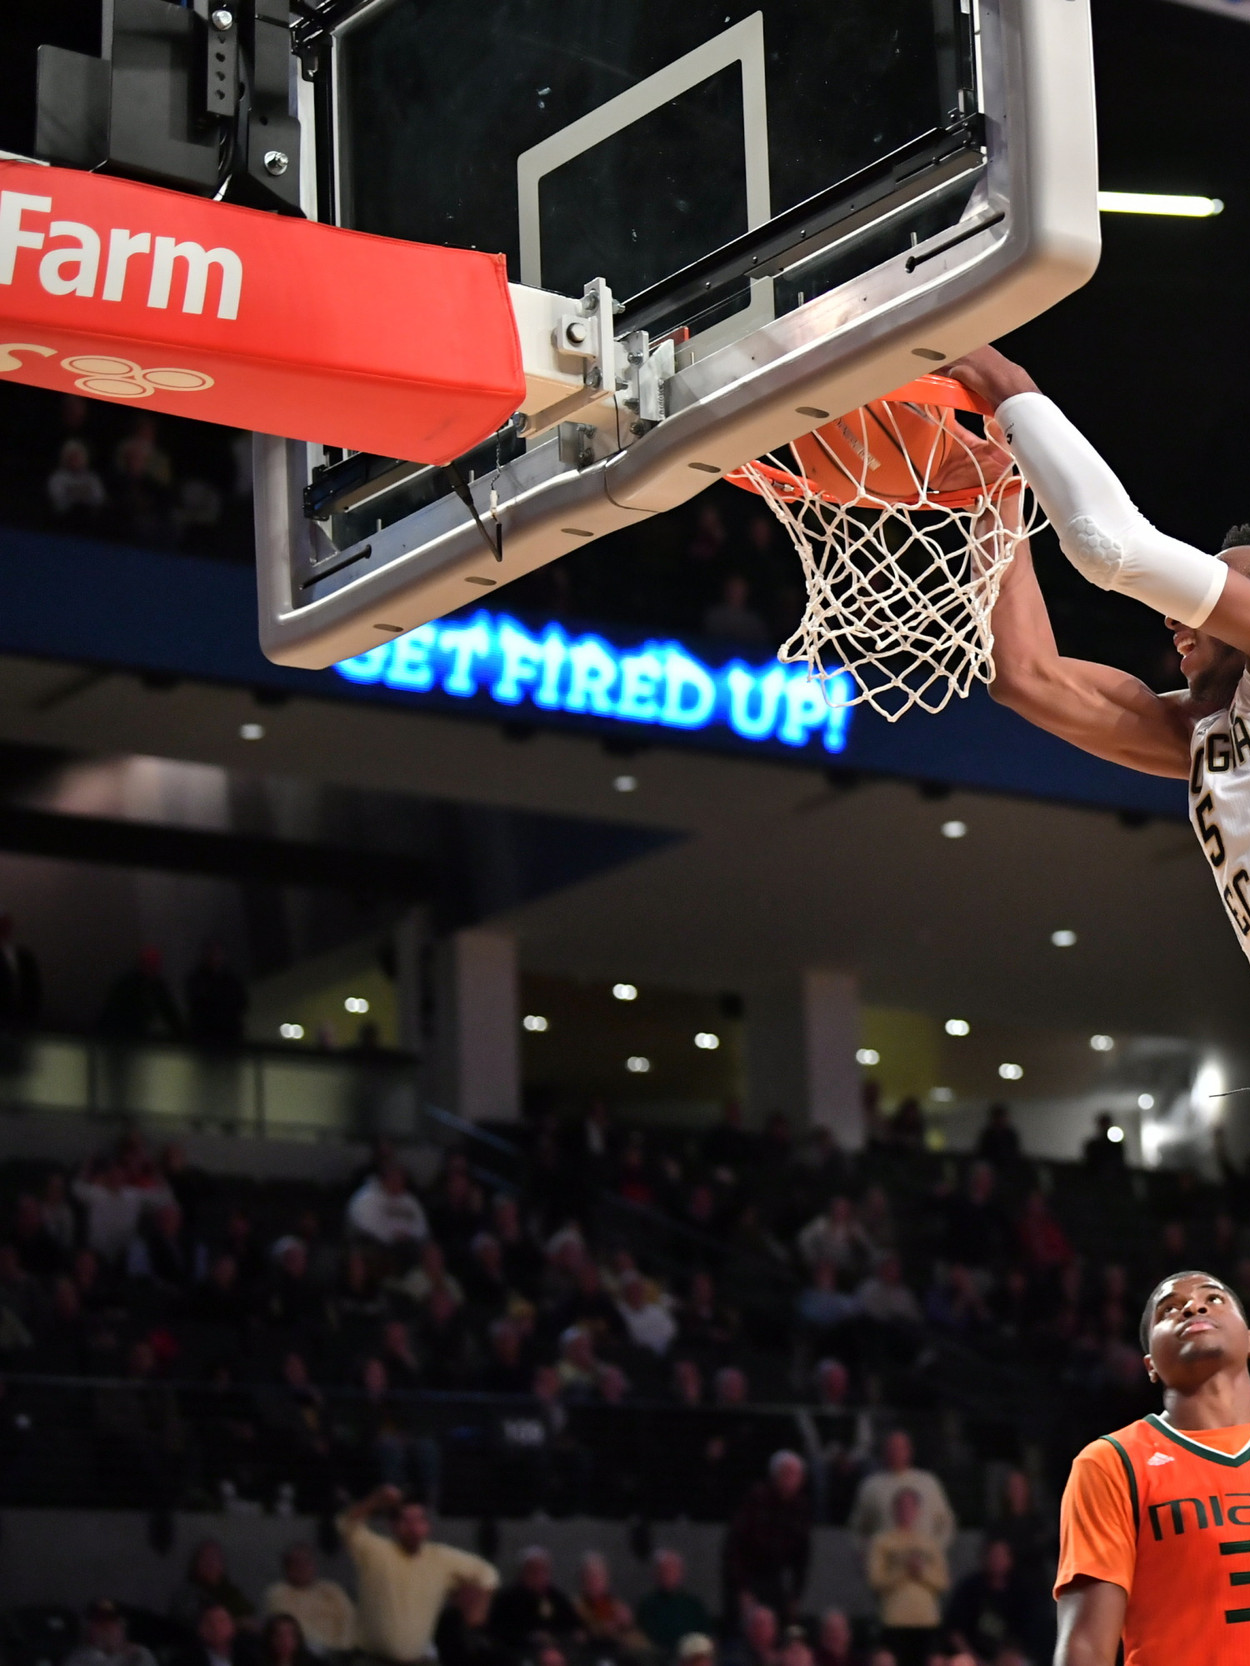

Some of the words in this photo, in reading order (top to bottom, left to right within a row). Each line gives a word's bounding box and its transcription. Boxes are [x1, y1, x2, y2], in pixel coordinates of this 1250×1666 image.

[0, 189, 243, 321] Farm
[492, 613, 714, 729] FIRED
[727, 660, 850, 753] UP!
[1195, 796, 1225, 868] 5
